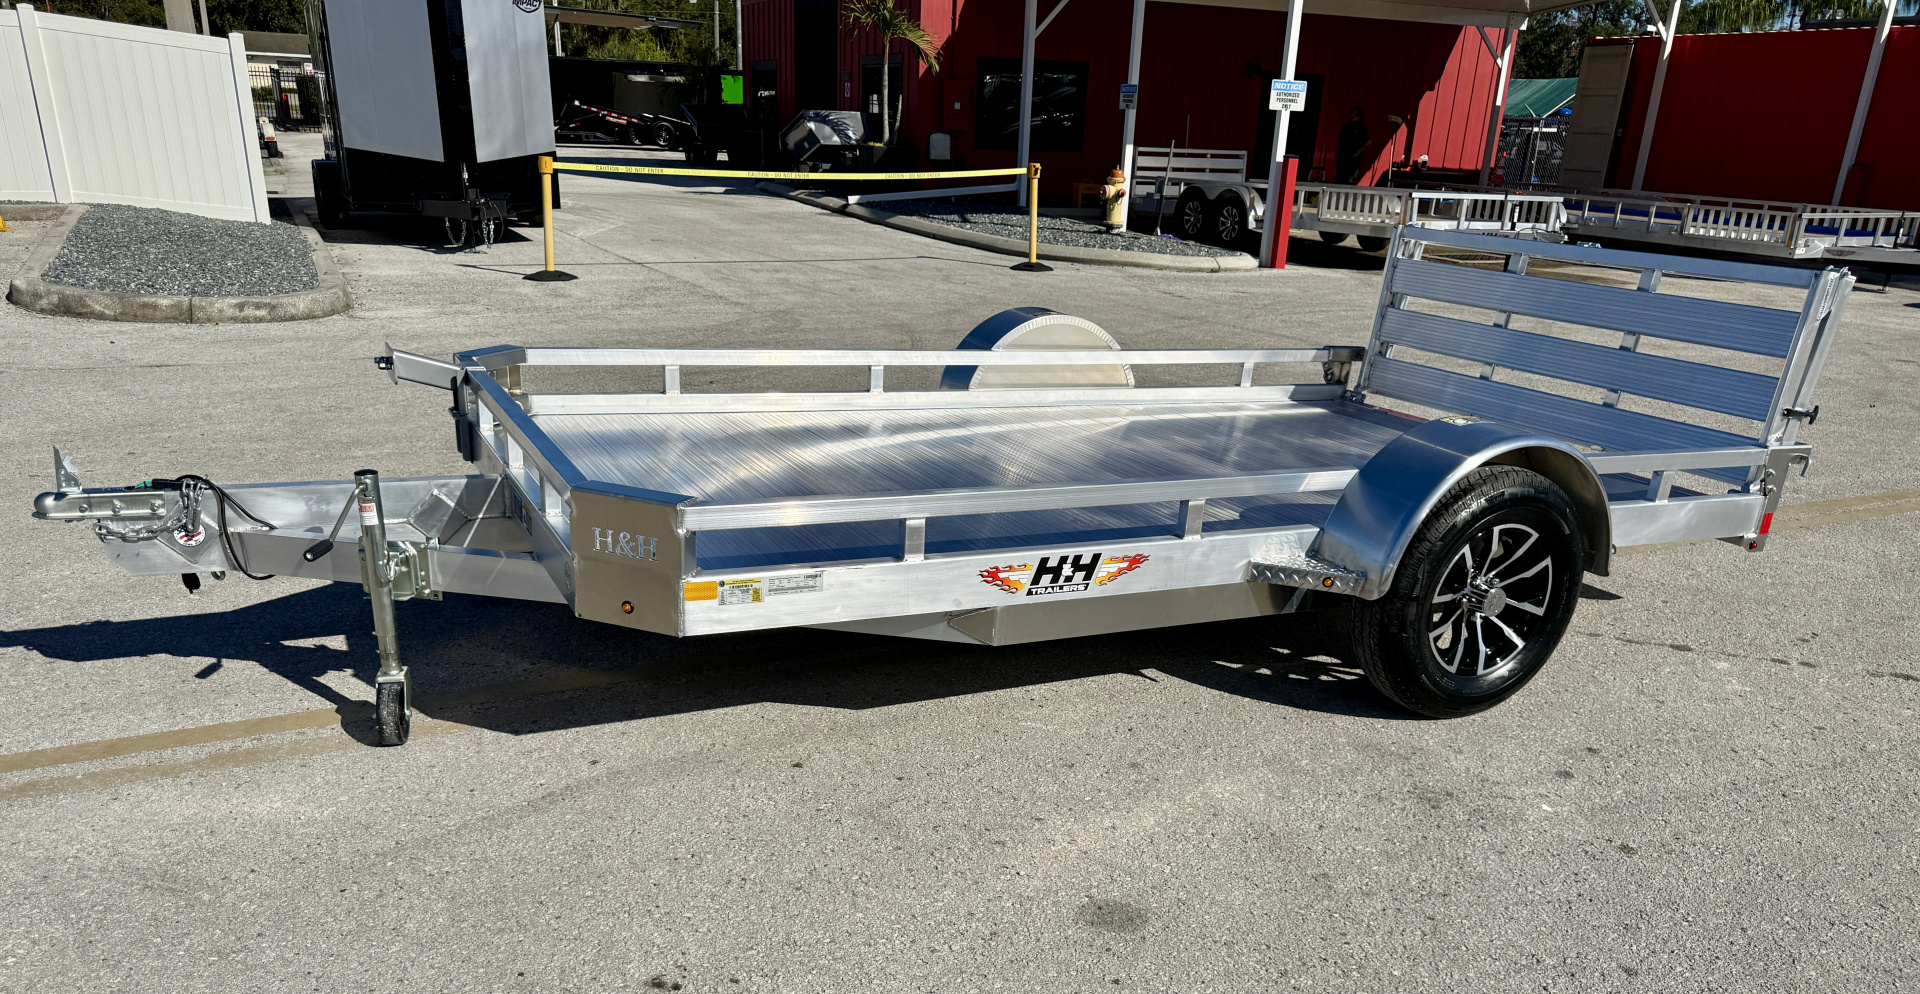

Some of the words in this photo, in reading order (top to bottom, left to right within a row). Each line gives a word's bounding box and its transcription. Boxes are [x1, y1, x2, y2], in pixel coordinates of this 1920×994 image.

[1273, 82, 1305, 91] NOTICE
[591, 526, 659, 563] H&H
[1029, 552, 1102, 587] H&H
[1030, 584, 1087, 596] TRAILERS
